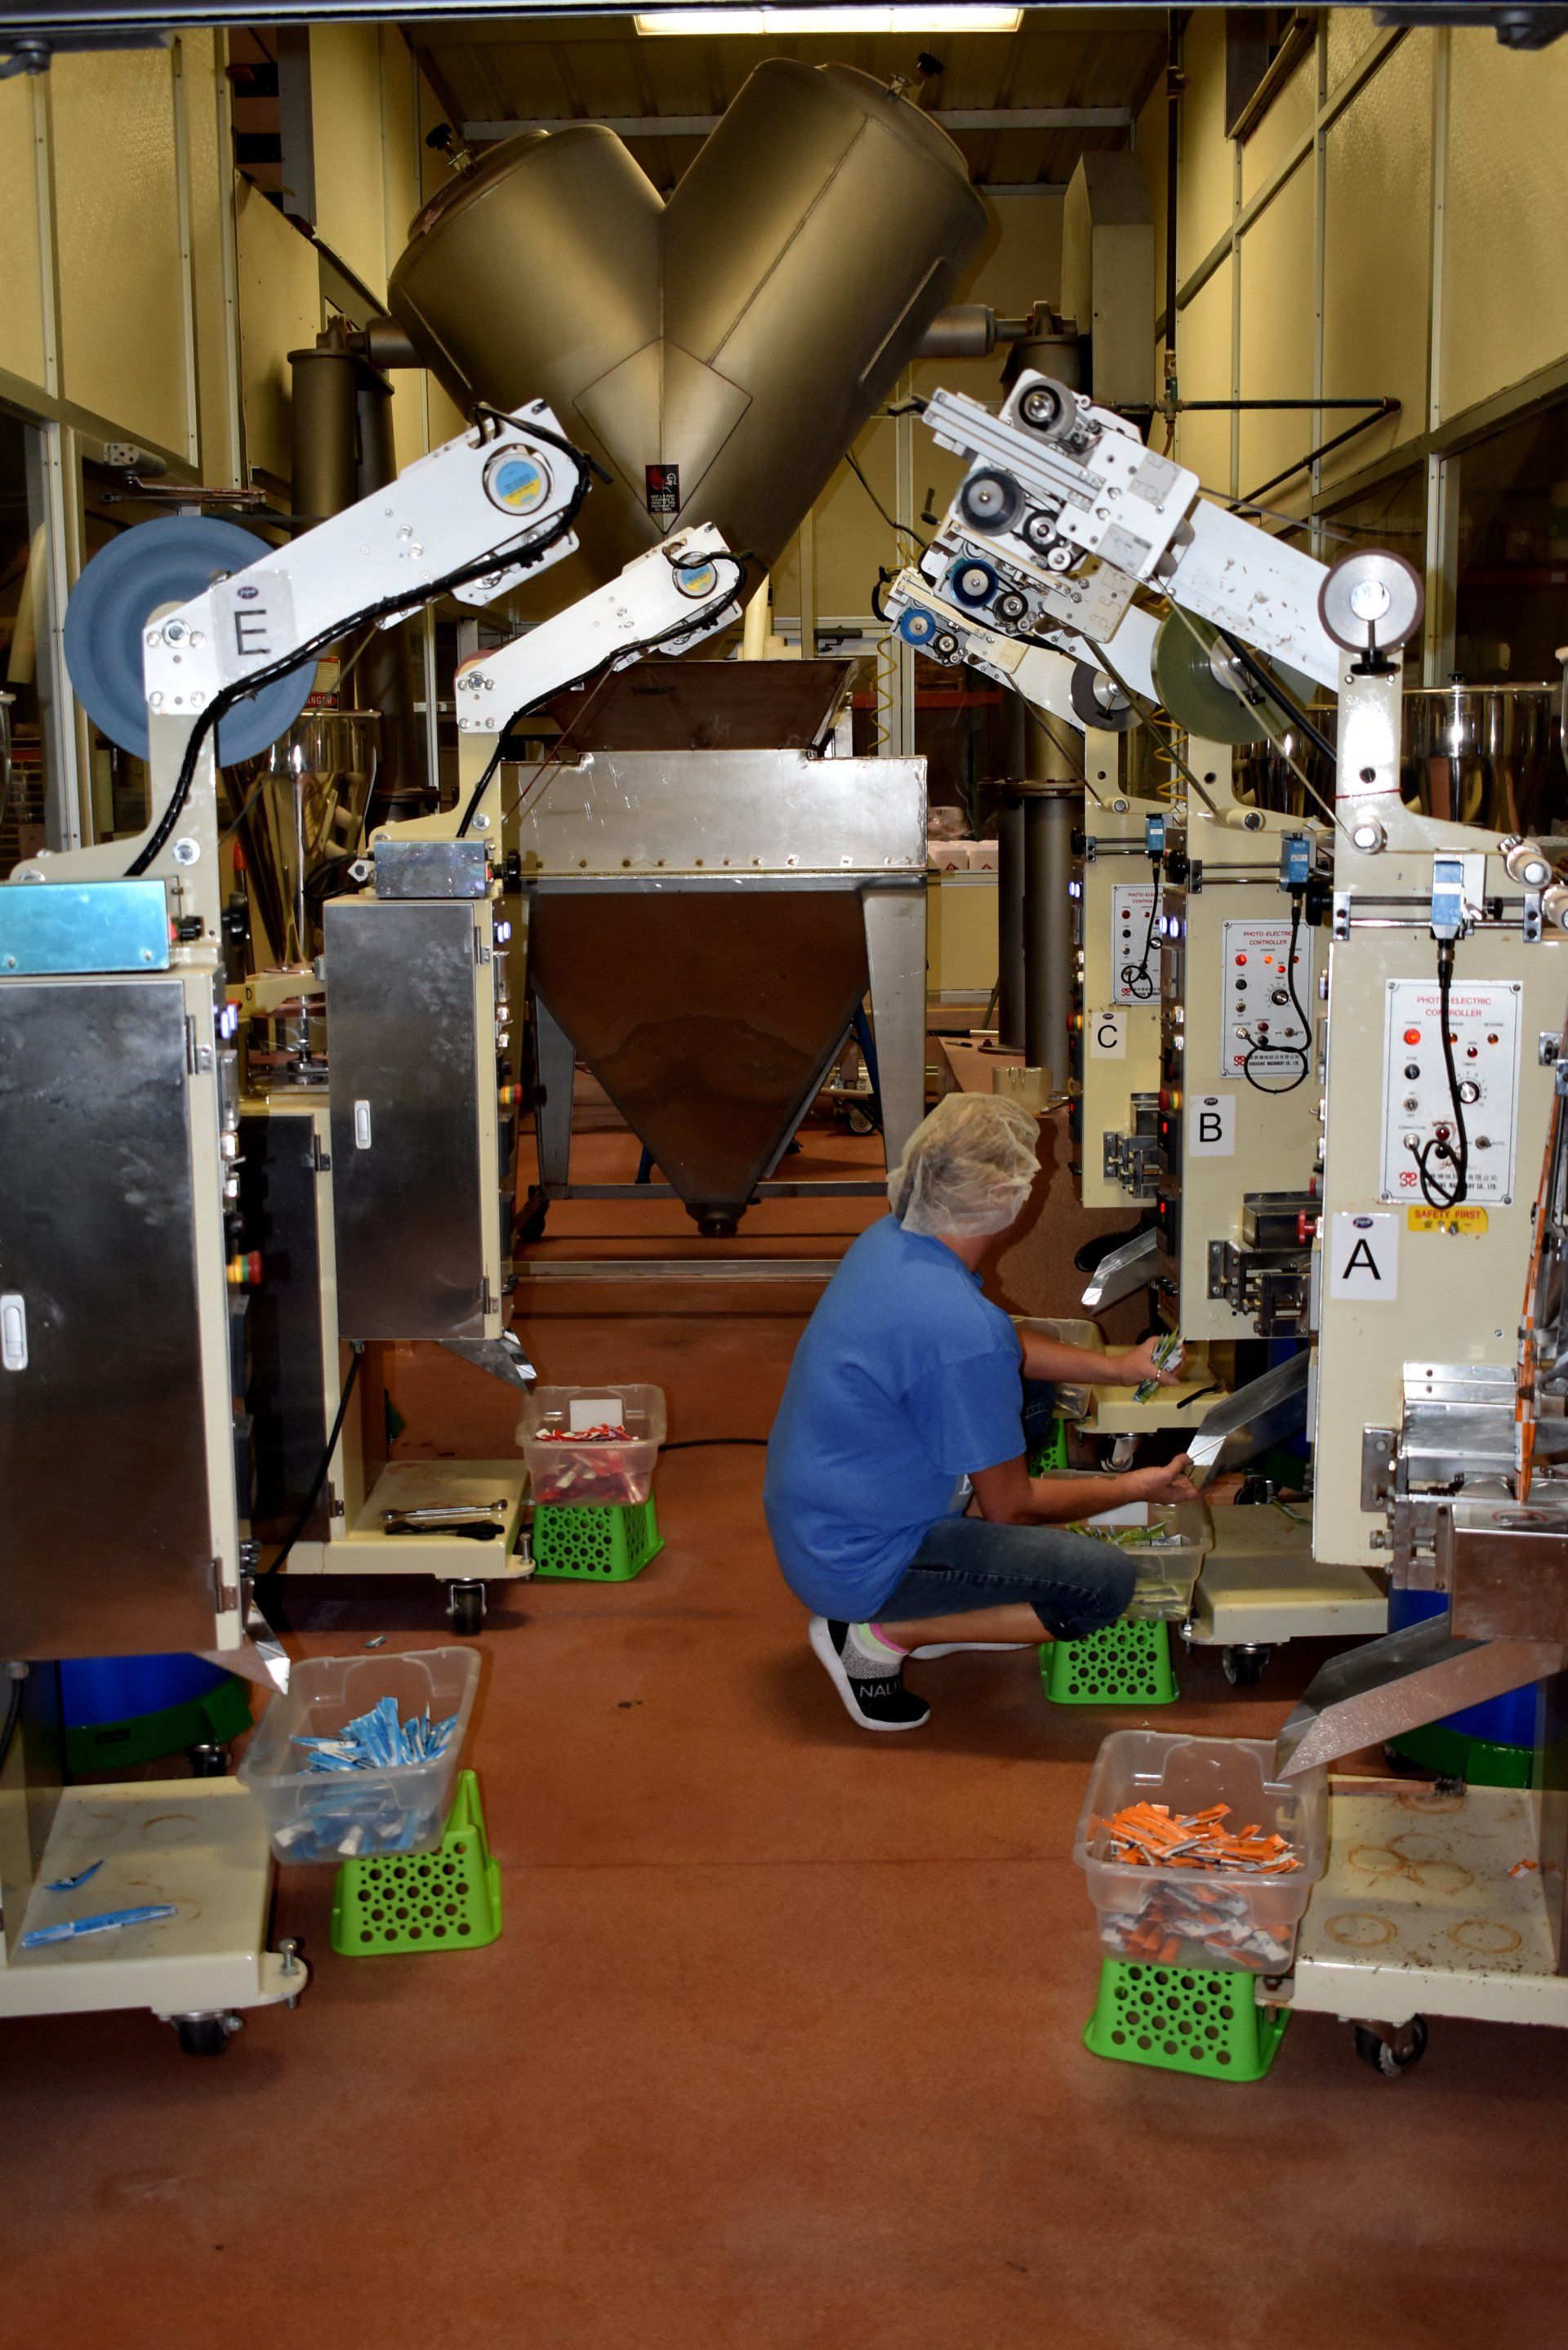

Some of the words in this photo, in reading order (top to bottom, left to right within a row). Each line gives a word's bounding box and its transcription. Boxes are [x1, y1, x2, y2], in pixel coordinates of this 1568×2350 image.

[234, 609, 271, 655] E
[307, 695, 332, 705] ANGR
[246, 987, 253, 1001] D
[1098, 1024, 1117, 1048] C
[1200, 1113, 1223, 1142] B
[1415, 1209, 1450, 1219] SAFETY
[1455, 1211, 1481, 1220] FIRST
[1342, 1238, 1382, 1280] A
